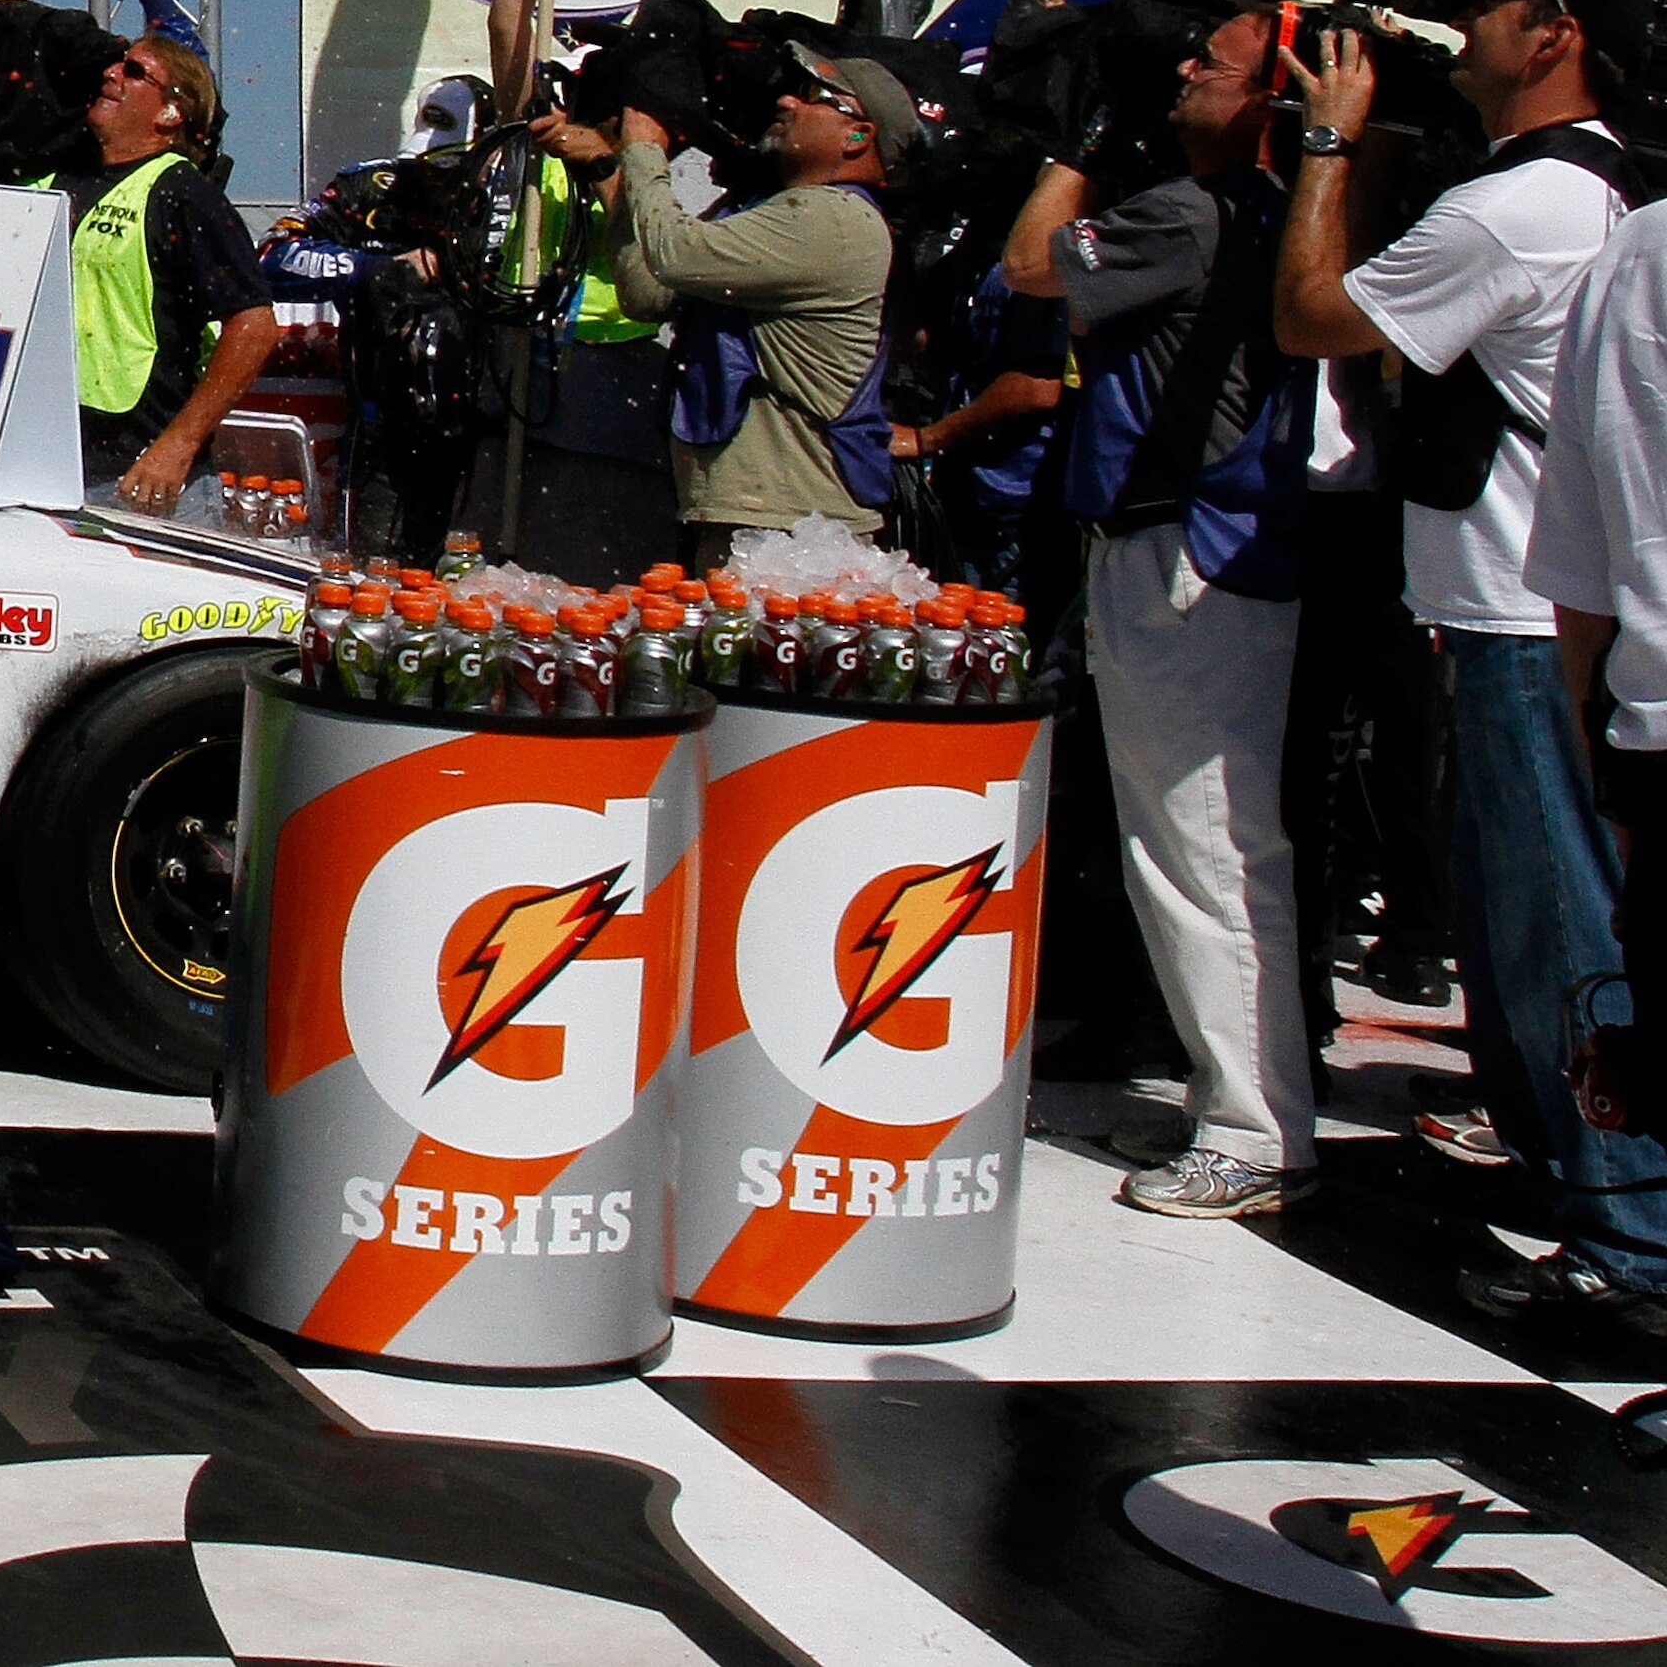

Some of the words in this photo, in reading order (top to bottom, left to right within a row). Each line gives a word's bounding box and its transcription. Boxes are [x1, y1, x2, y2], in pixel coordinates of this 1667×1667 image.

[87, 220, 127, 238] FOX
[140, 597, 305, 641] GOODY
[712, 633, 733, 655] G
[776, 641, 797, 664] G
[397, 648, 420, 674] G
[461, 653, 481, 677] G
[838, 647, 858, 671] G
[895, 648, 915, 672] G
[989, 652, 1007, 674] G
[536, 662, 555, 686] G
[736, 781, 1020, 1126] G
[341, 798, 647, 1159] G
[736, 1147, 1002, 1217] SERIES
[340, 1176, 634, 1256] SERIES
